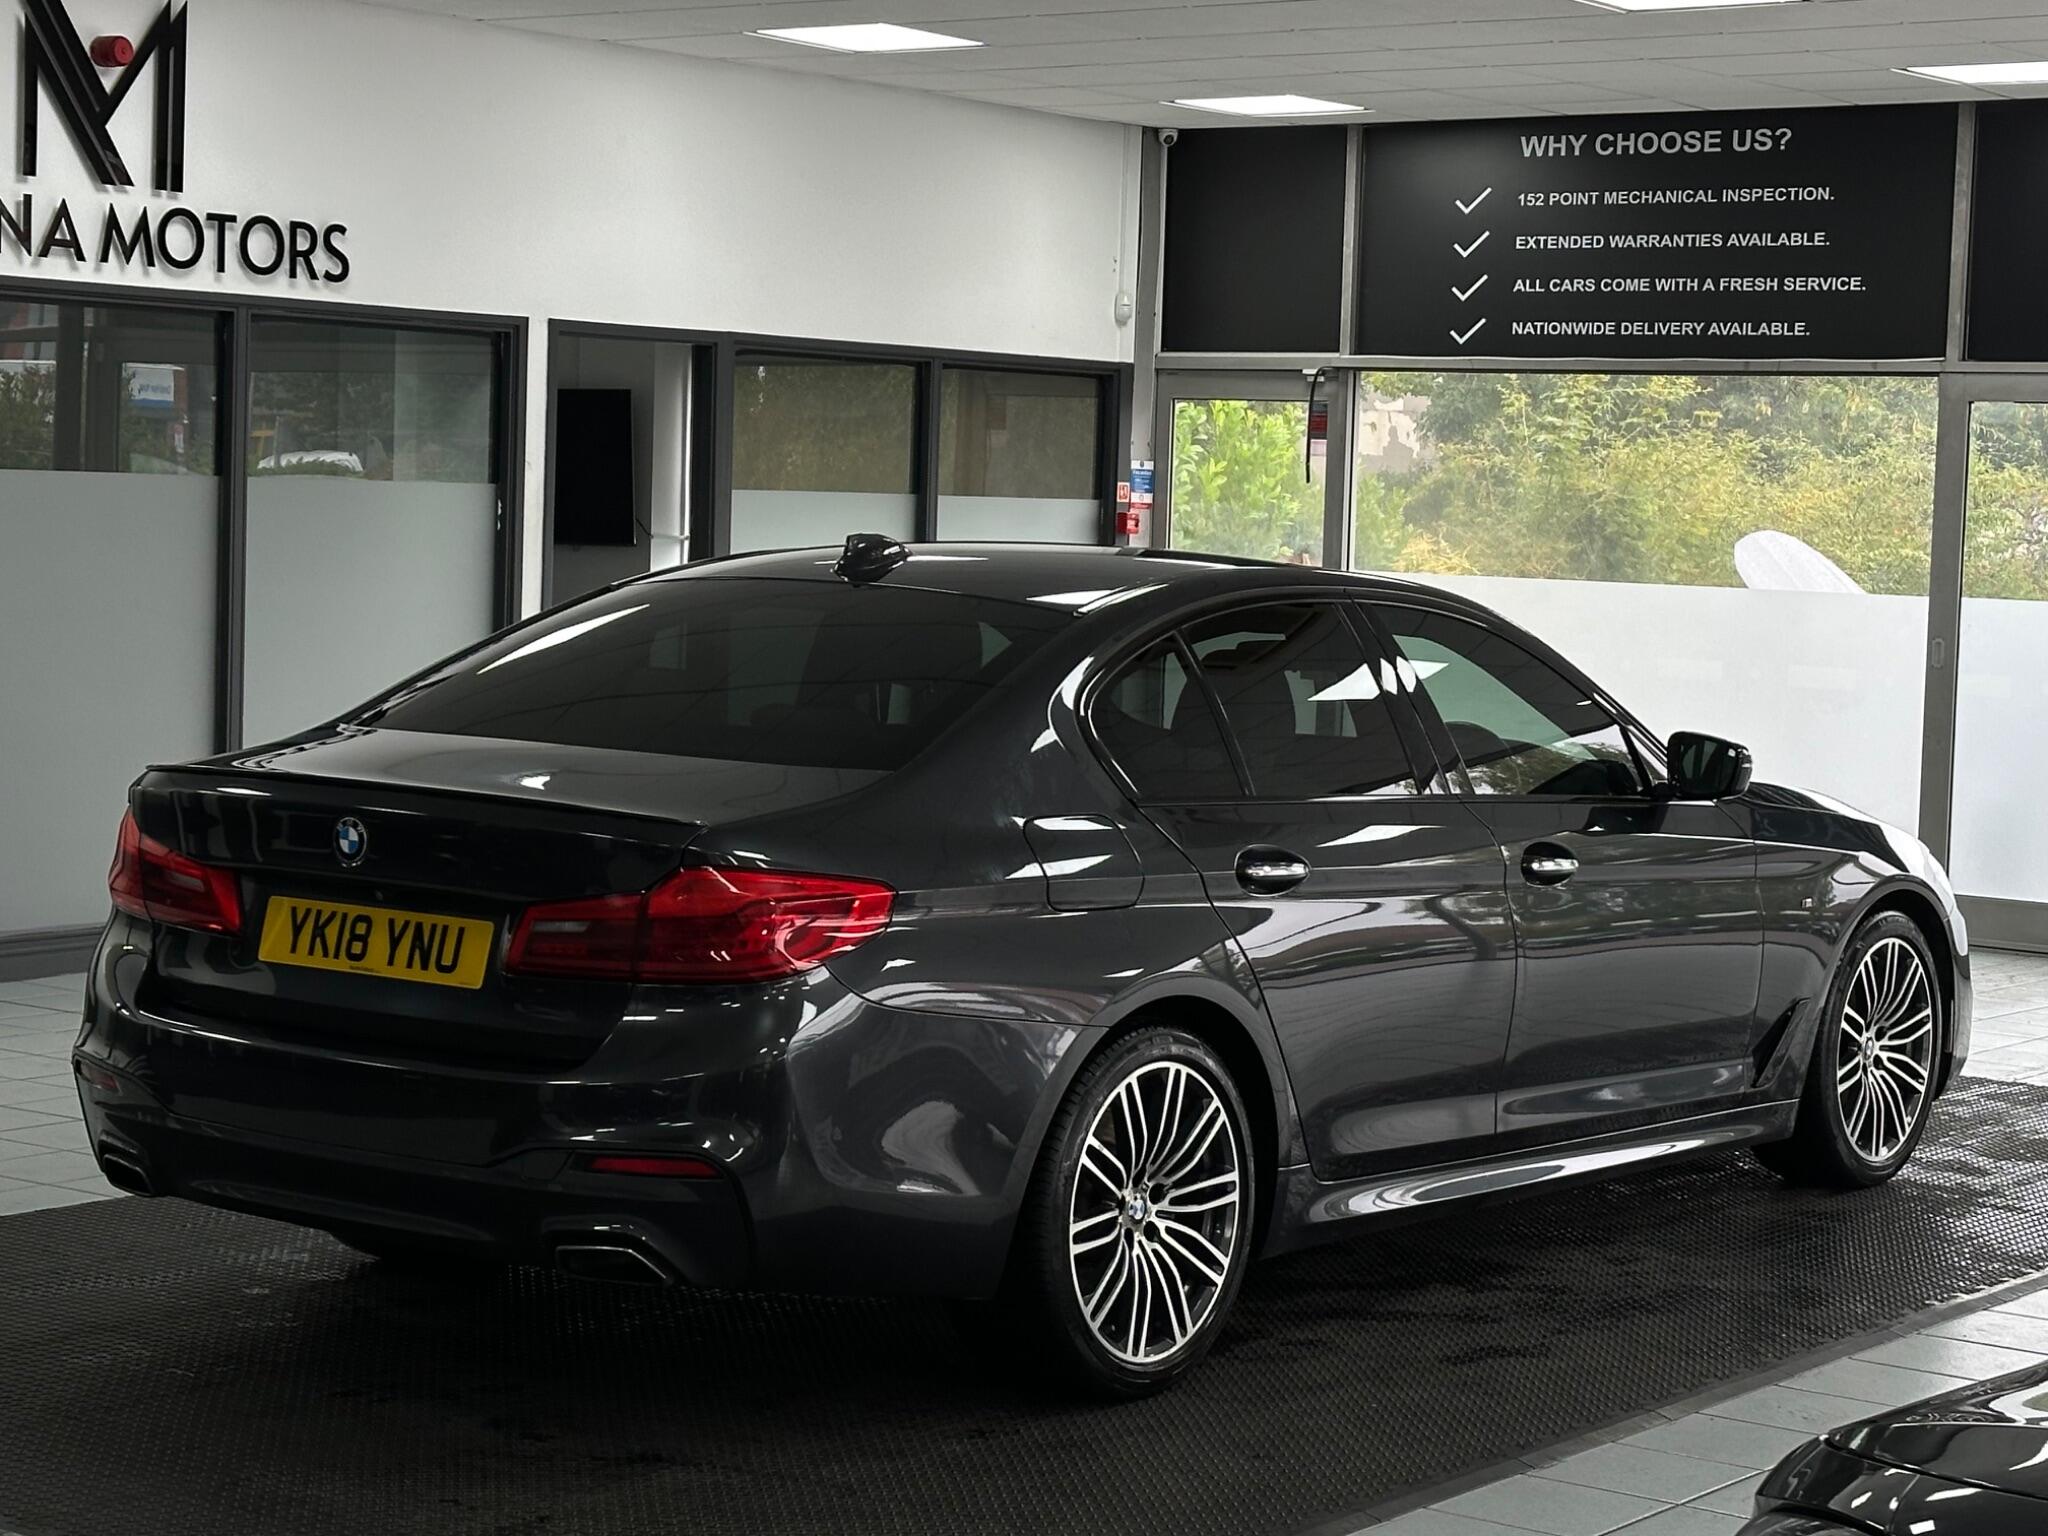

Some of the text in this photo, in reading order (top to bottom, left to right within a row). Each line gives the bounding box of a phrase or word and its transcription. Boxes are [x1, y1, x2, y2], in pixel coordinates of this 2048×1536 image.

[1520, 128, 1793, 158] WHY CHOOSE US?
[1517, 187, 1835, 206] 152 POINT MECHANICAL INSPECTION.
[99, 202, 350, 284] MOTORS
[1515, 232, 1831, 250] EXTENDED WARRANTIES AVAILABLE.
[1512, 276, 1867, 293] ALL CARS COME WITH A FRESH SERVICE.
[1511, 321, 1811, 337] NATIONWIDE DELIVERY AVAILABLE.
[289, 905, 466, 974] YK18 YNU
